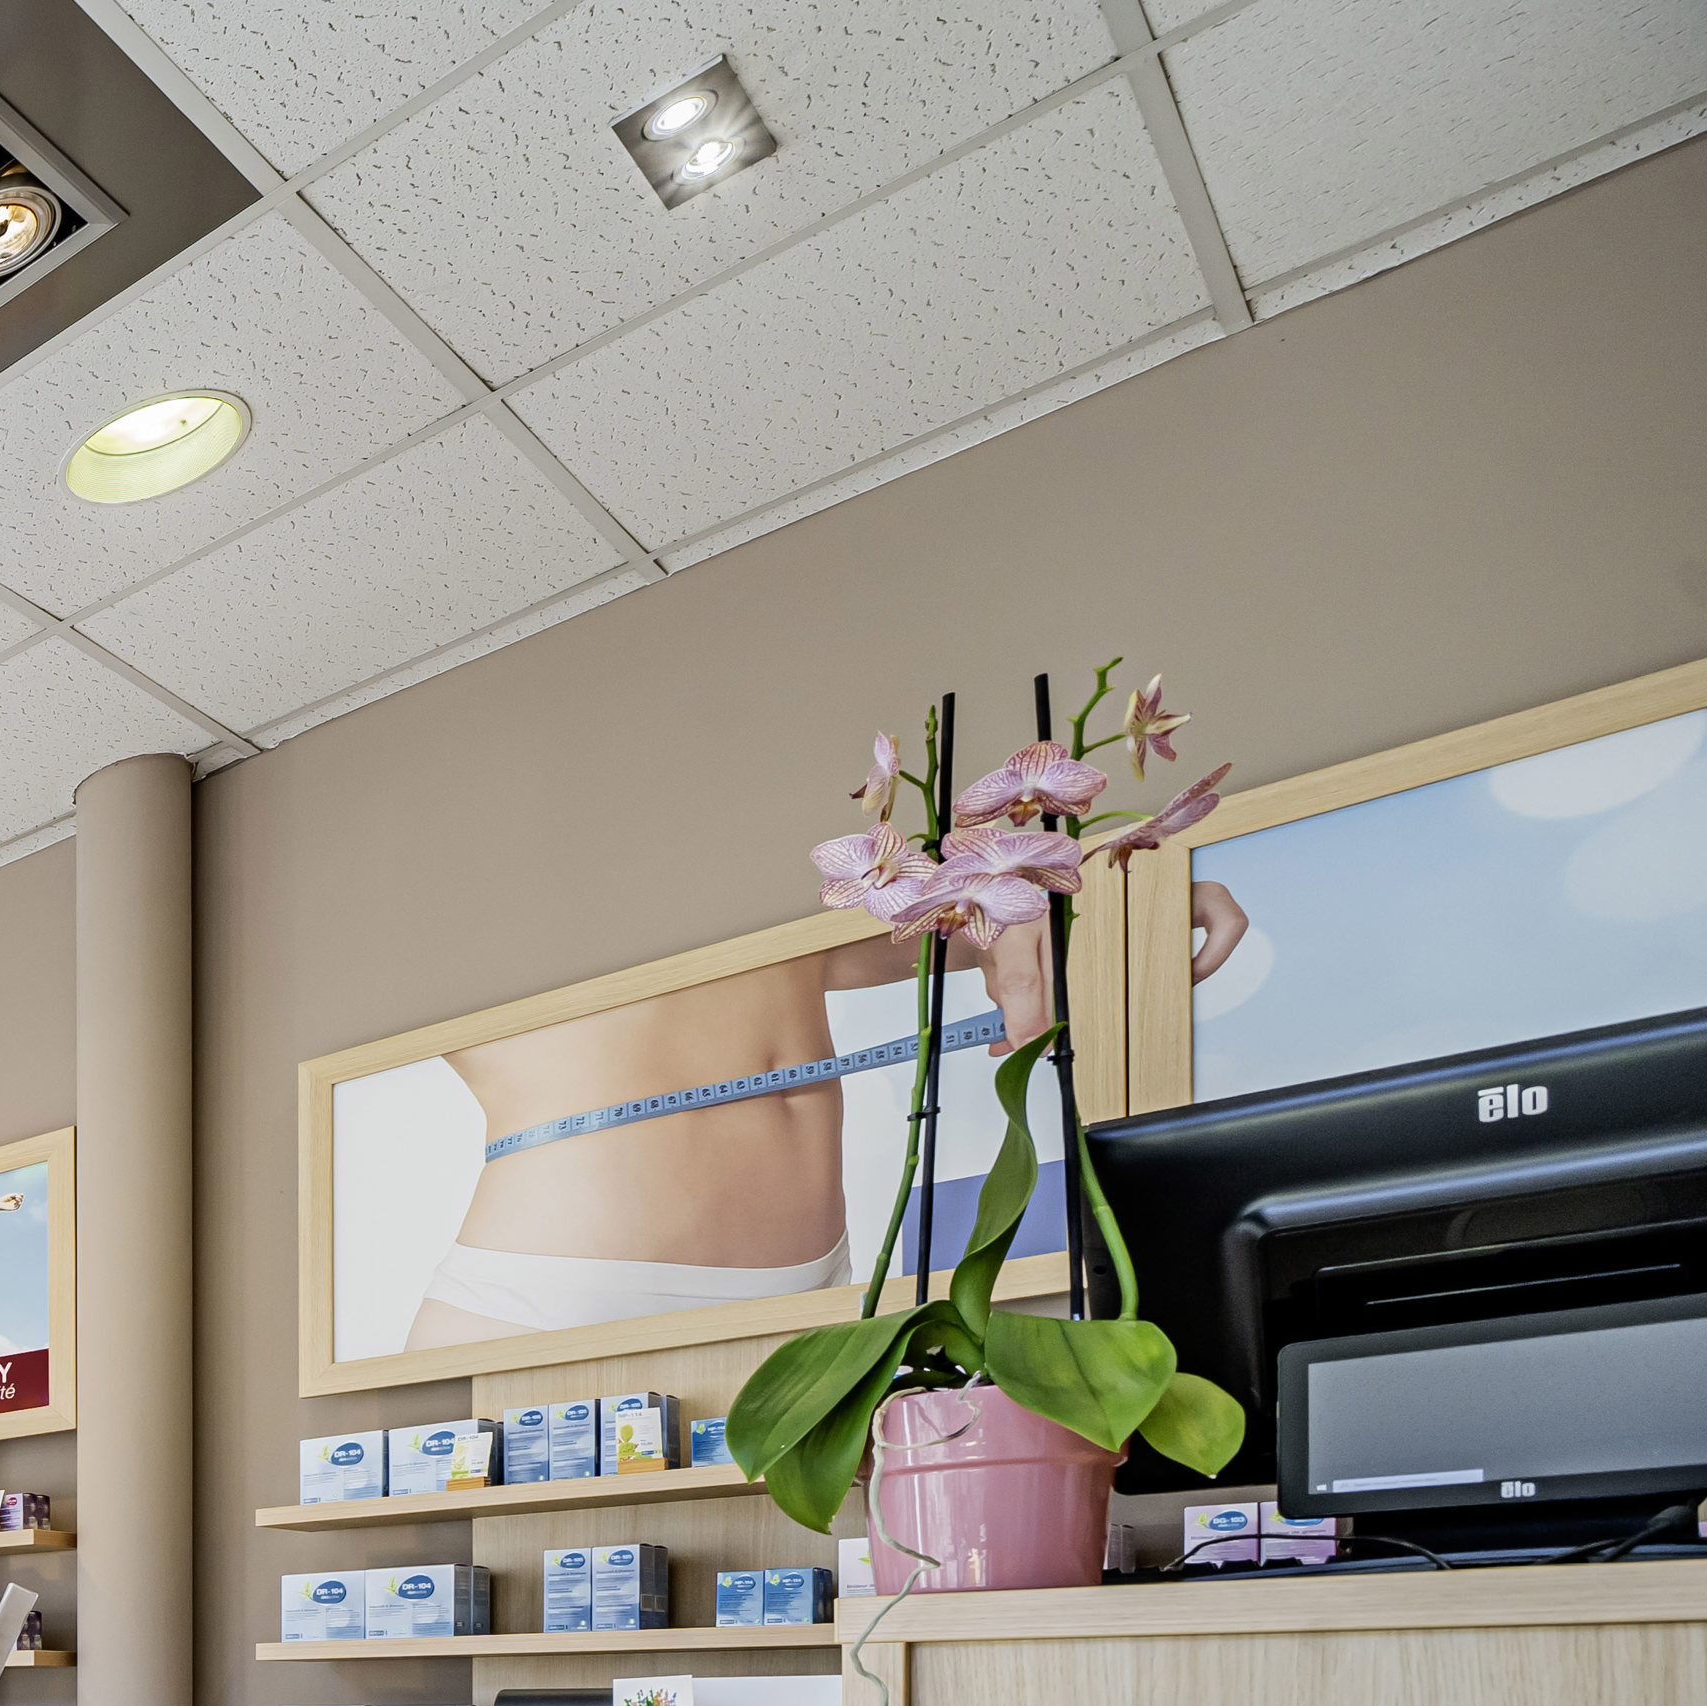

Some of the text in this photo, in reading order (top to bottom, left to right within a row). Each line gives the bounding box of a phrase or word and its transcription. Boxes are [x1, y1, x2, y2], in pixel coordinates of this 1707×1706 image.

[334, 1449, 361, 1458] DR-104
[402, 1582, 432, 1591] DR-104
[316, 1588, 344, 1596] DR-104
